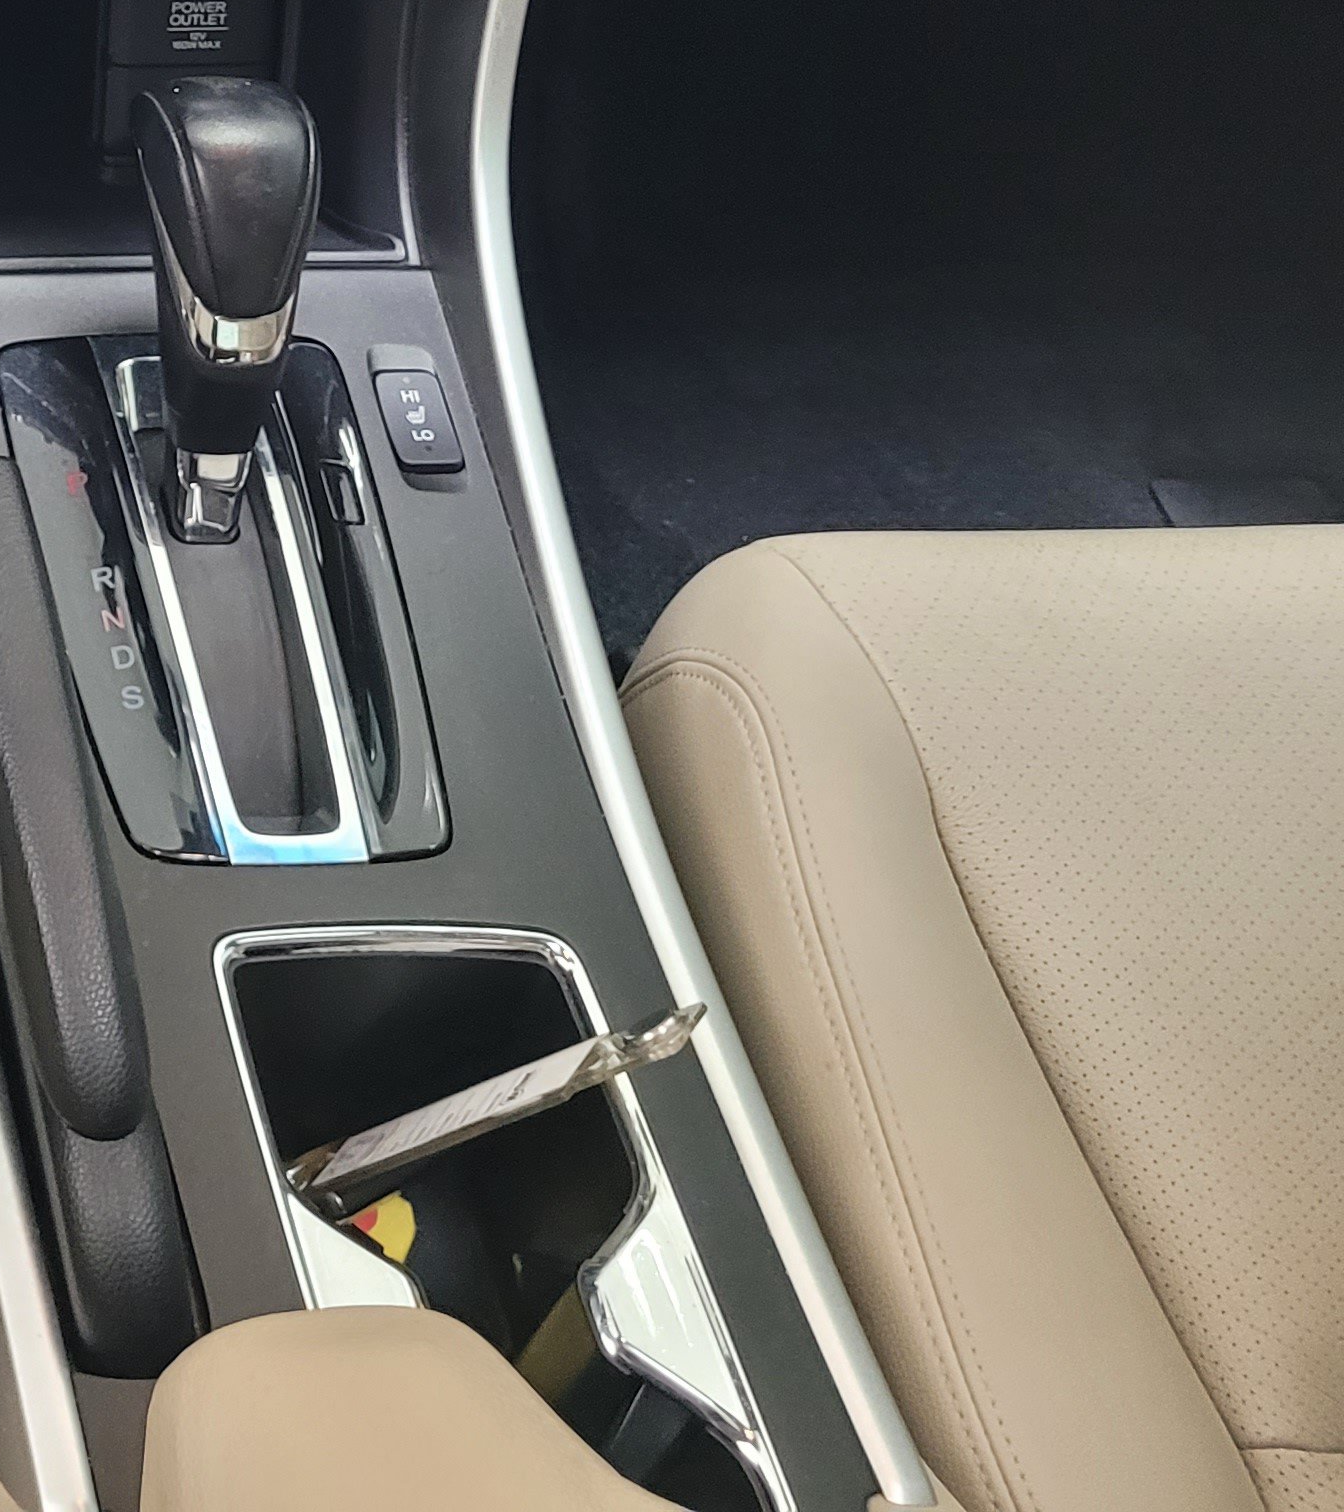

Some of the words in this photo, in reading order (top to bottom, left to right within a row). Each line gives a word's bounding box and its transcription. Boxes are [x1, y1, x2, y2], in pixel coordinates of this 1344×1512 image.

[171, 1, 227, 14] POWER
[169, 13, 228, 26] OUTLET
[400, 389, 421, 403] HI
[411, 429, 435, 442] LO
[90, 566, 116, 592] R
[101, 607, 126, 632] N
[110, 645, 135, 670] D
[121, 686, 144, 710] S
